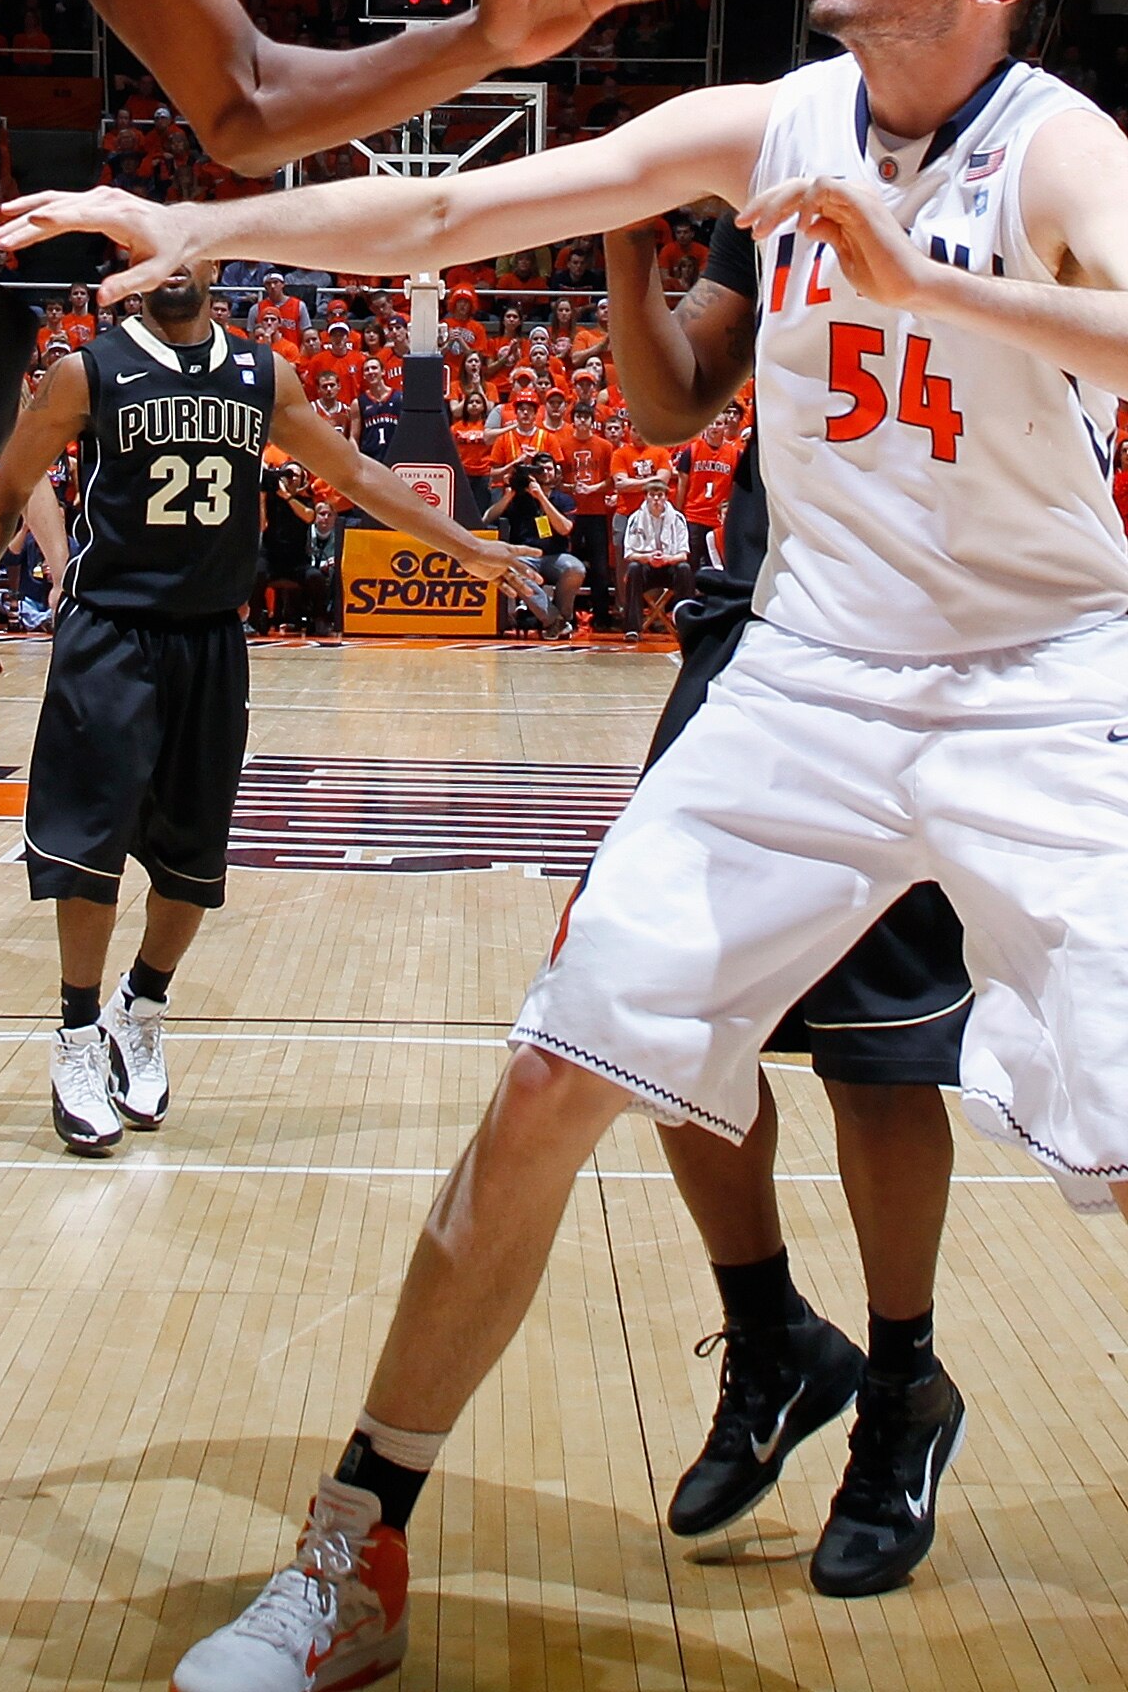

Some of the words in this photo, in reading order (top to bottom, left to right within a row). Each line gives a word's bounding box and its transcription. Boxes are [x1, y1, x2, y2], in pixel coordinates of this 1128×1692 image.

[825, 321, 964, 464] 54
[118, 396, 263, 457] PURDUE
[378, 427, 386, 445] 1
[693, 459, 732, 476] ILLINOIS
[146, 455, 233, 526] 23
[704, 481, 714, 499] 1
[345, 578, 489, 615] SPORTS
